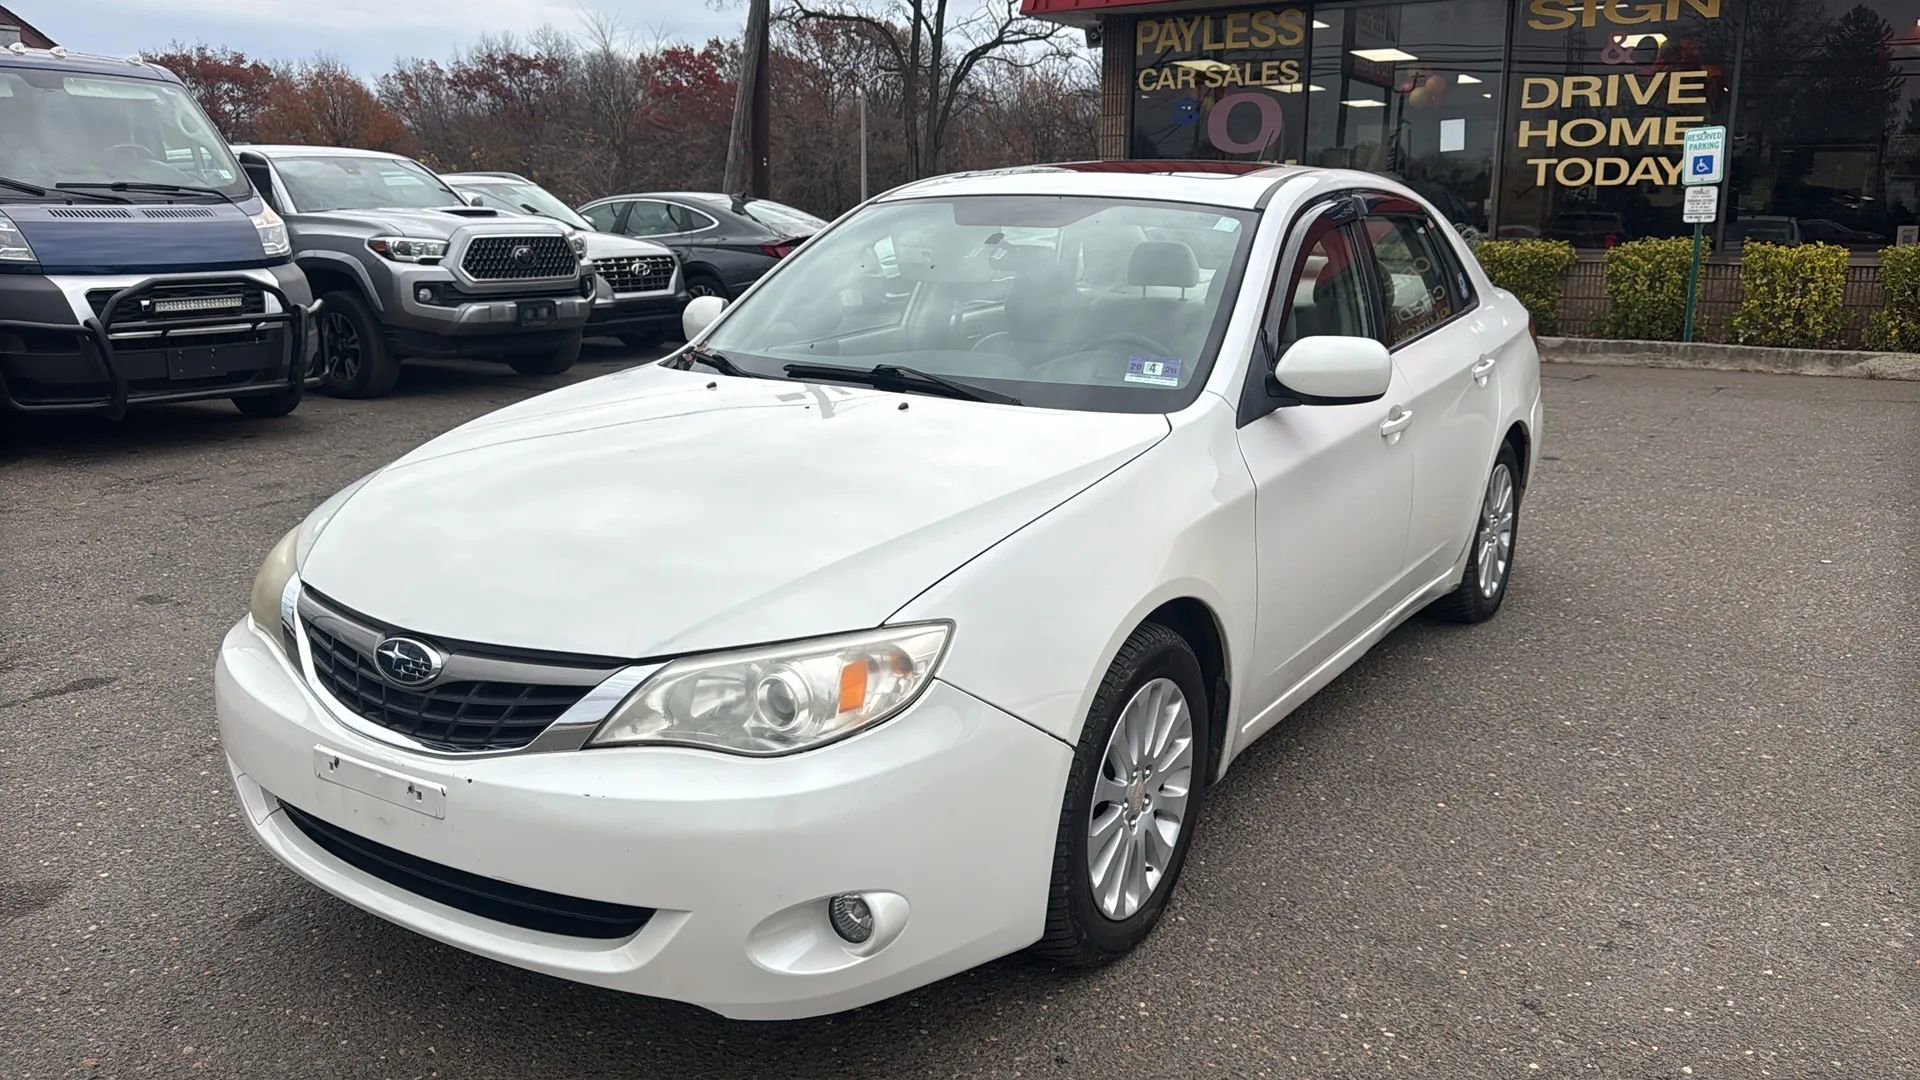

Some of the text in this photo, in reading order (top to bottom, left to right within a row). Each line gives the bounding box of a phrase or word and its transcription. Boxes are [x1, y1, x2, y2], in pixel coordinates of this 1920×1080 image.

[1136, 9, 1304, 56] PAYLESS
[1600, 31, 1636, 65] &
[1138, 60, 1299, 92] CAR SALES
[1521, 70, 1708, 109] DRIVE
[1518, 116, 1704, 148] HOME
[1688, 131, 1722, 142] RESERVED
[1689, 141, 1719, 151] PARKING
[1527, 157, 1684, 187] TODAY
[1149, 363, 1157, 374] 4
